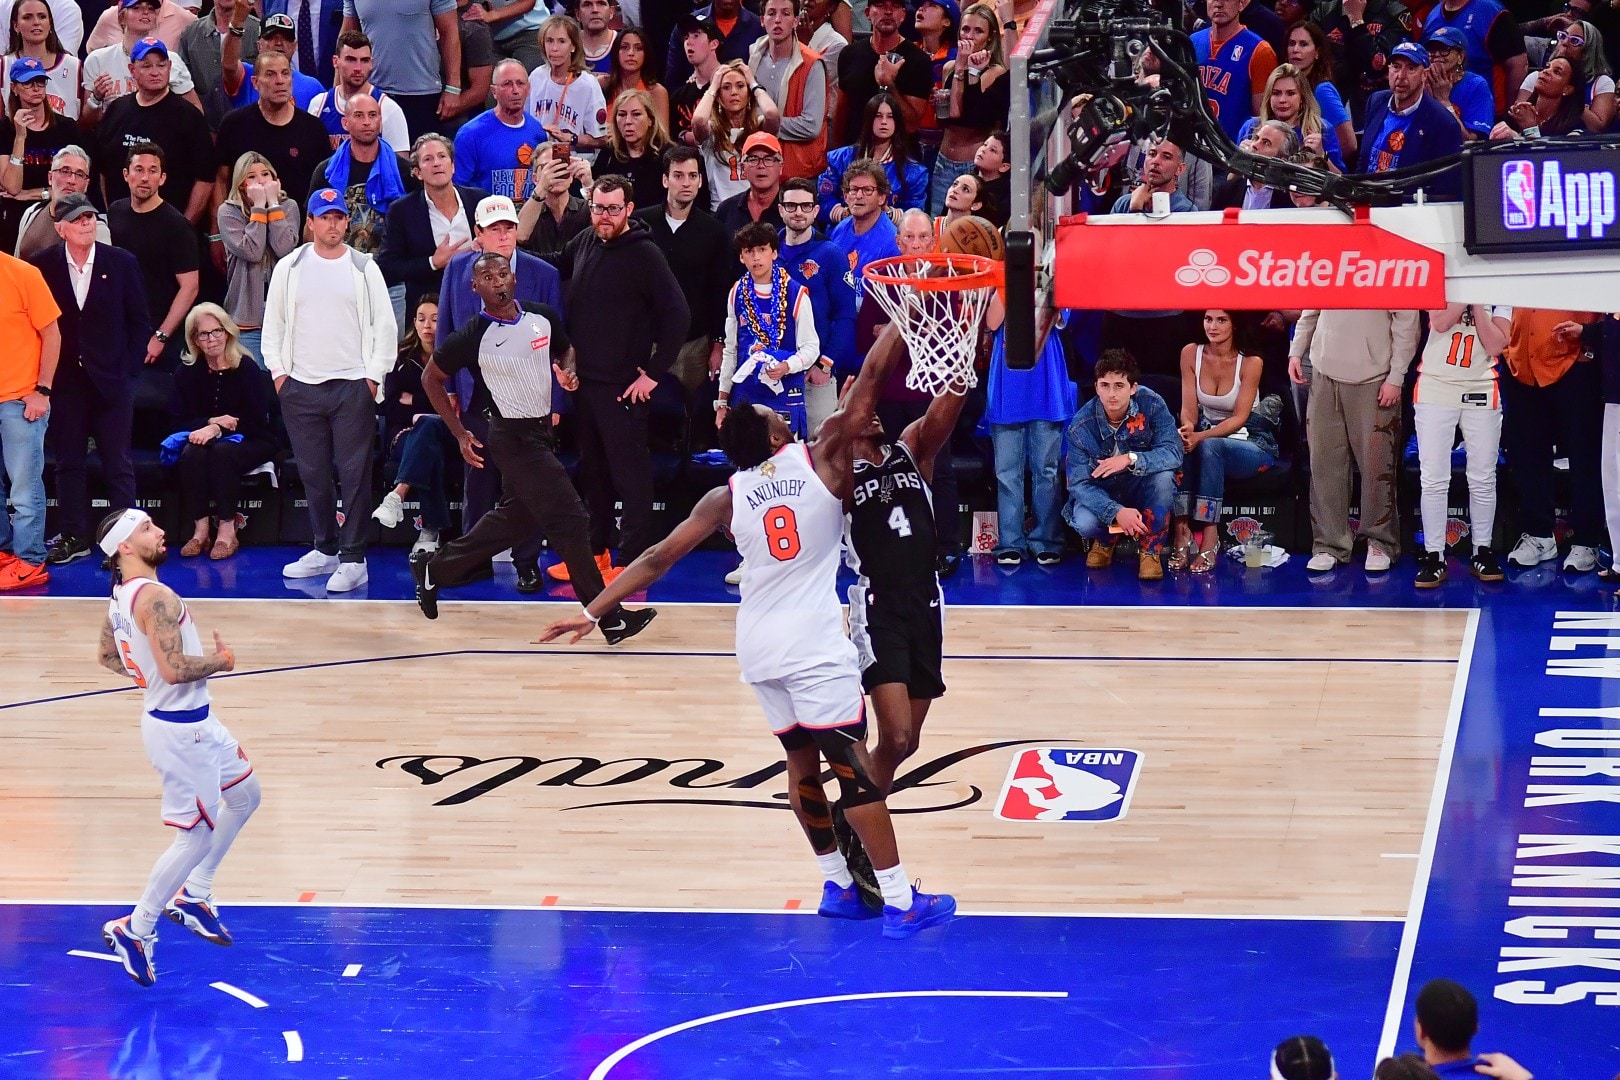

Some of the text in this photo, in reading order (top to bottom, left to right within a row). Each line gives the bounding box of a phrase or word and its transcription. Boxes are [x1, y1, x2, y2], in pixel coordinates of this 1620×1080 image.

[535, 99, 579, 129] NEW YORK
[1540, 160, 1616, 239] App
[1446, 331, 1475, 368] 11
[746, 479, 806, 510] ANUNOBY
[853, 472, 921, 506] SPURS
[763, 505, 802, 561] 8
[888, 506, 912, 537] 4
[120, 640, 148, 689] 5
[1065, 750, 1125, 767] NBA
[1524, 707, 1620, 808] YORK
[1493, 833, 1620, 1008] KNICKS
